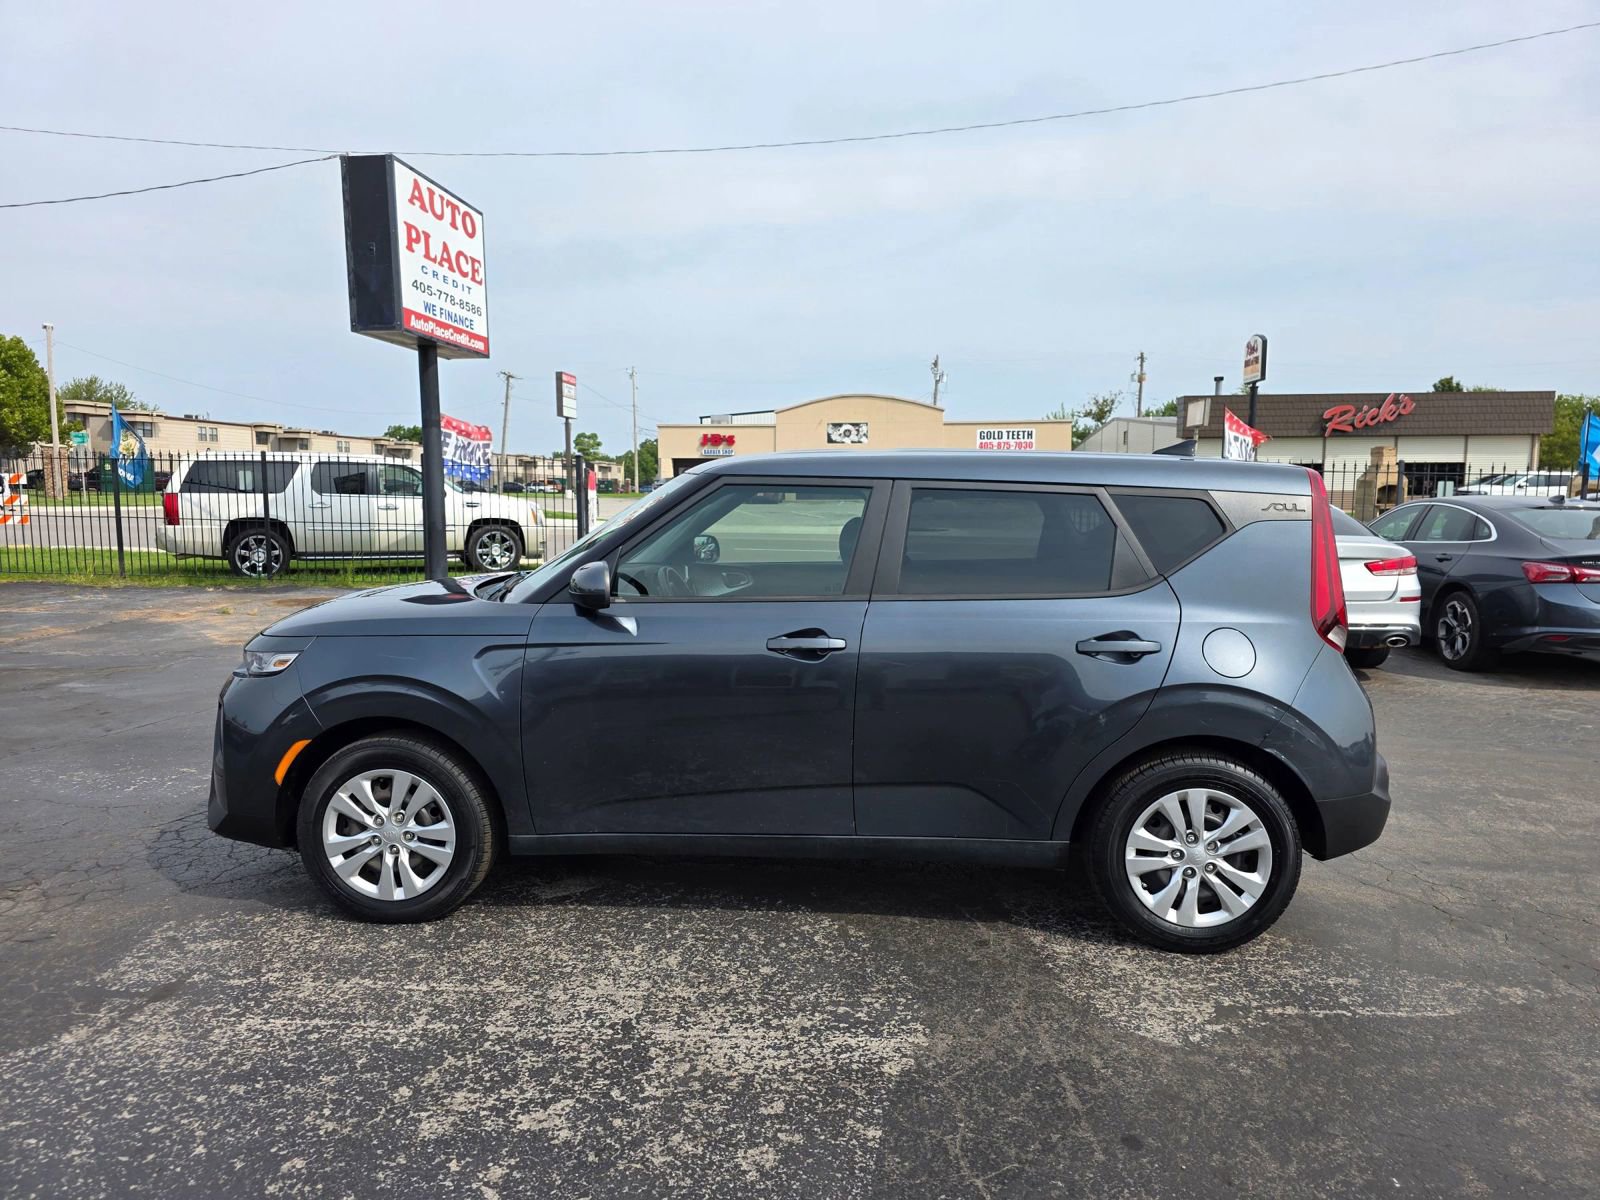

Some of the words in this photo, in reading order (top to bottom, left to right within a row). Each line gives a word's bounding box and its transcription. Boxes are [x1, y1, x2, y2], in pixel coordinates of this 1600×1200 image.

[408, 178, 476, 239] AUTO
[403, 221, 483, 286] PLACE
[421, 265, 472, 295] CREDIT
[411, 280, 482, 317] 405-778-8586
[410, 314, 485, 351] AutoPlaceCredit.com
[423, 301, 437, 317] WE
[440, 308, 474, 331] FINANCE
[1322, 392, 1416, 438] Rick's
[979, 430, 1003, 440] GOLD
[1005, 430, 1033, 440] TEETH
[979, 441, 1034, 450] 405-875-7030
[1261, 502, 1306, 512] SOUL
